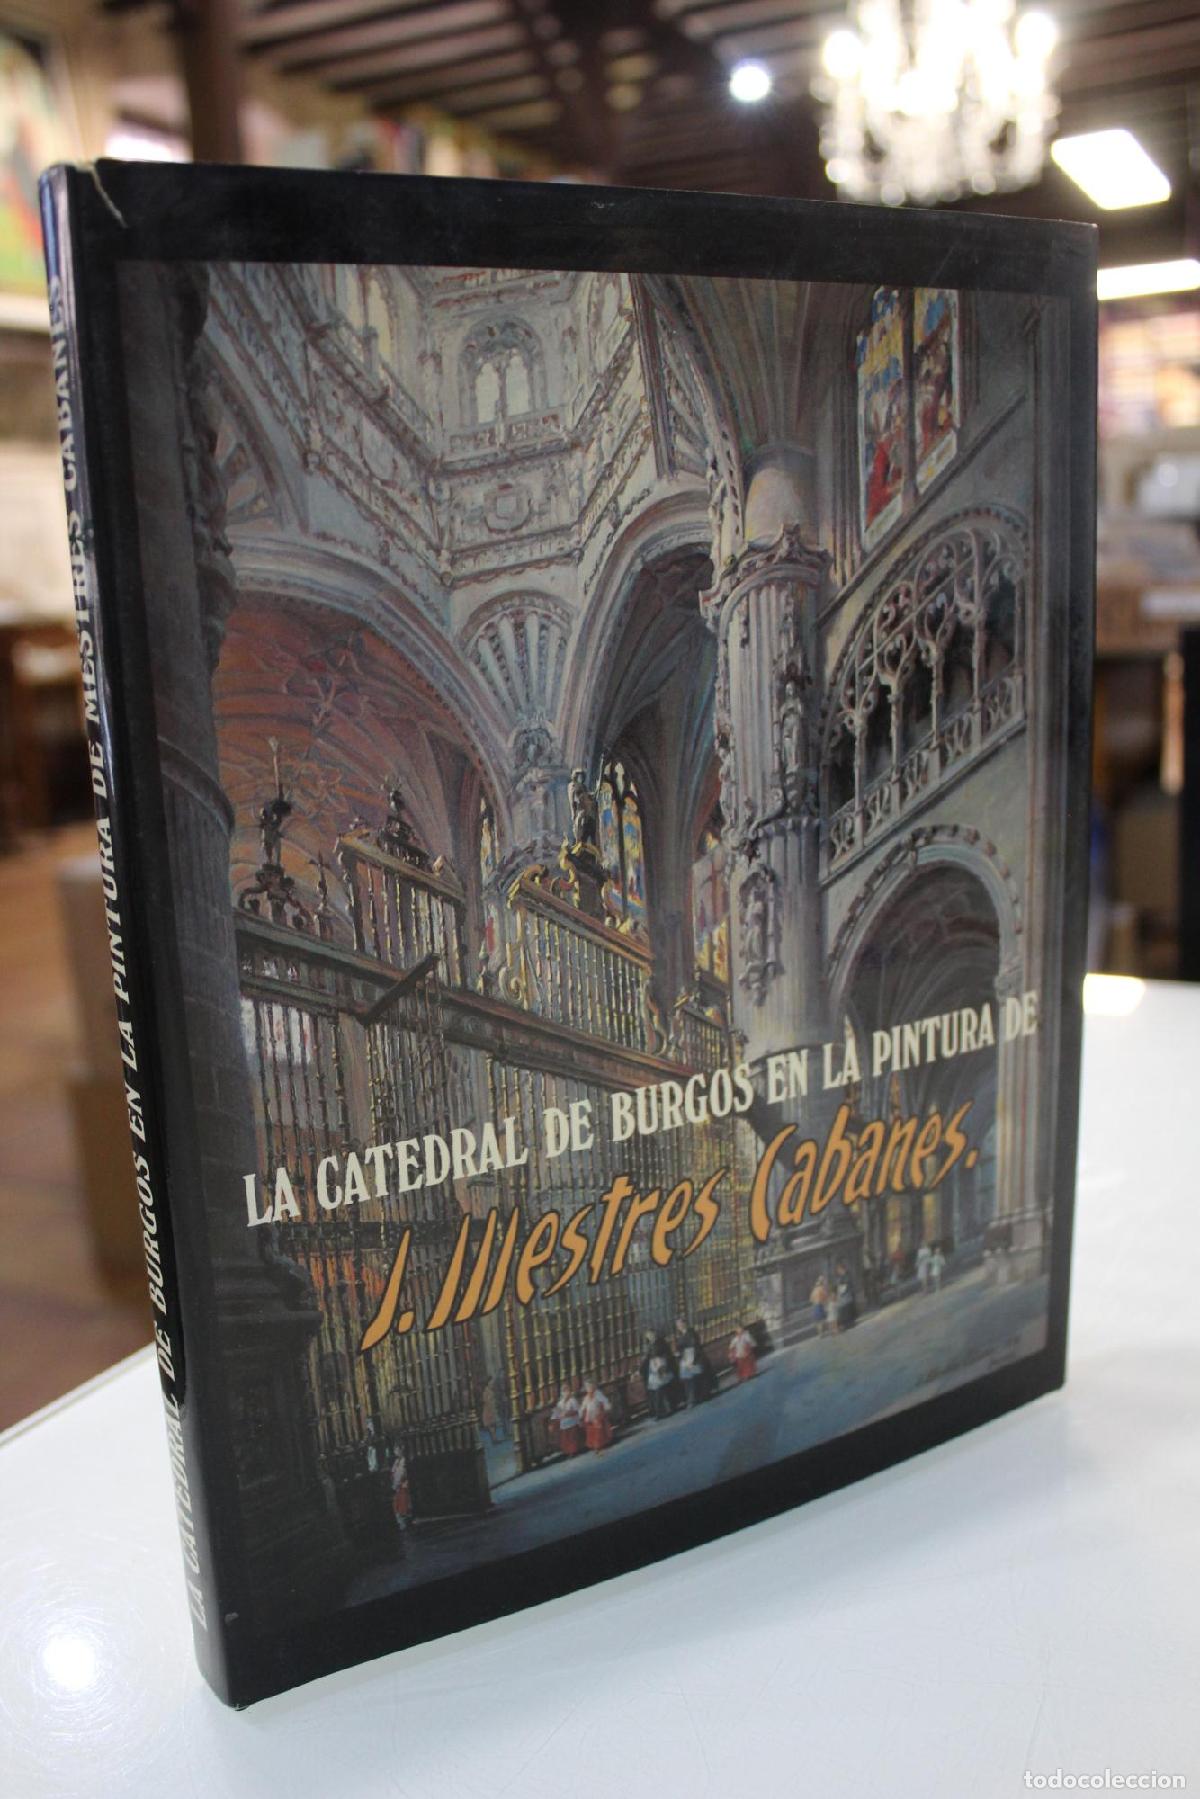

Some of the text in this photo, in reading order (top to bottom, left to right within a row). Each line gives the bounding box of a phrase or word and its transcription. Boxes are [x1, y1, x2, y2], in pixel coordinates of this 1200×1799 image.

[51, 274, 208, 1631] LA CATEDRAL DE BURGOS EN LA PINTURA DE MESTRES CABANES
[243, 992, 1037, 1227] LA CATEDRAL DE BURGOS EN LA PINTURA DE
[360, 1099, 979, 1352] J. Mestres Cabanes.
